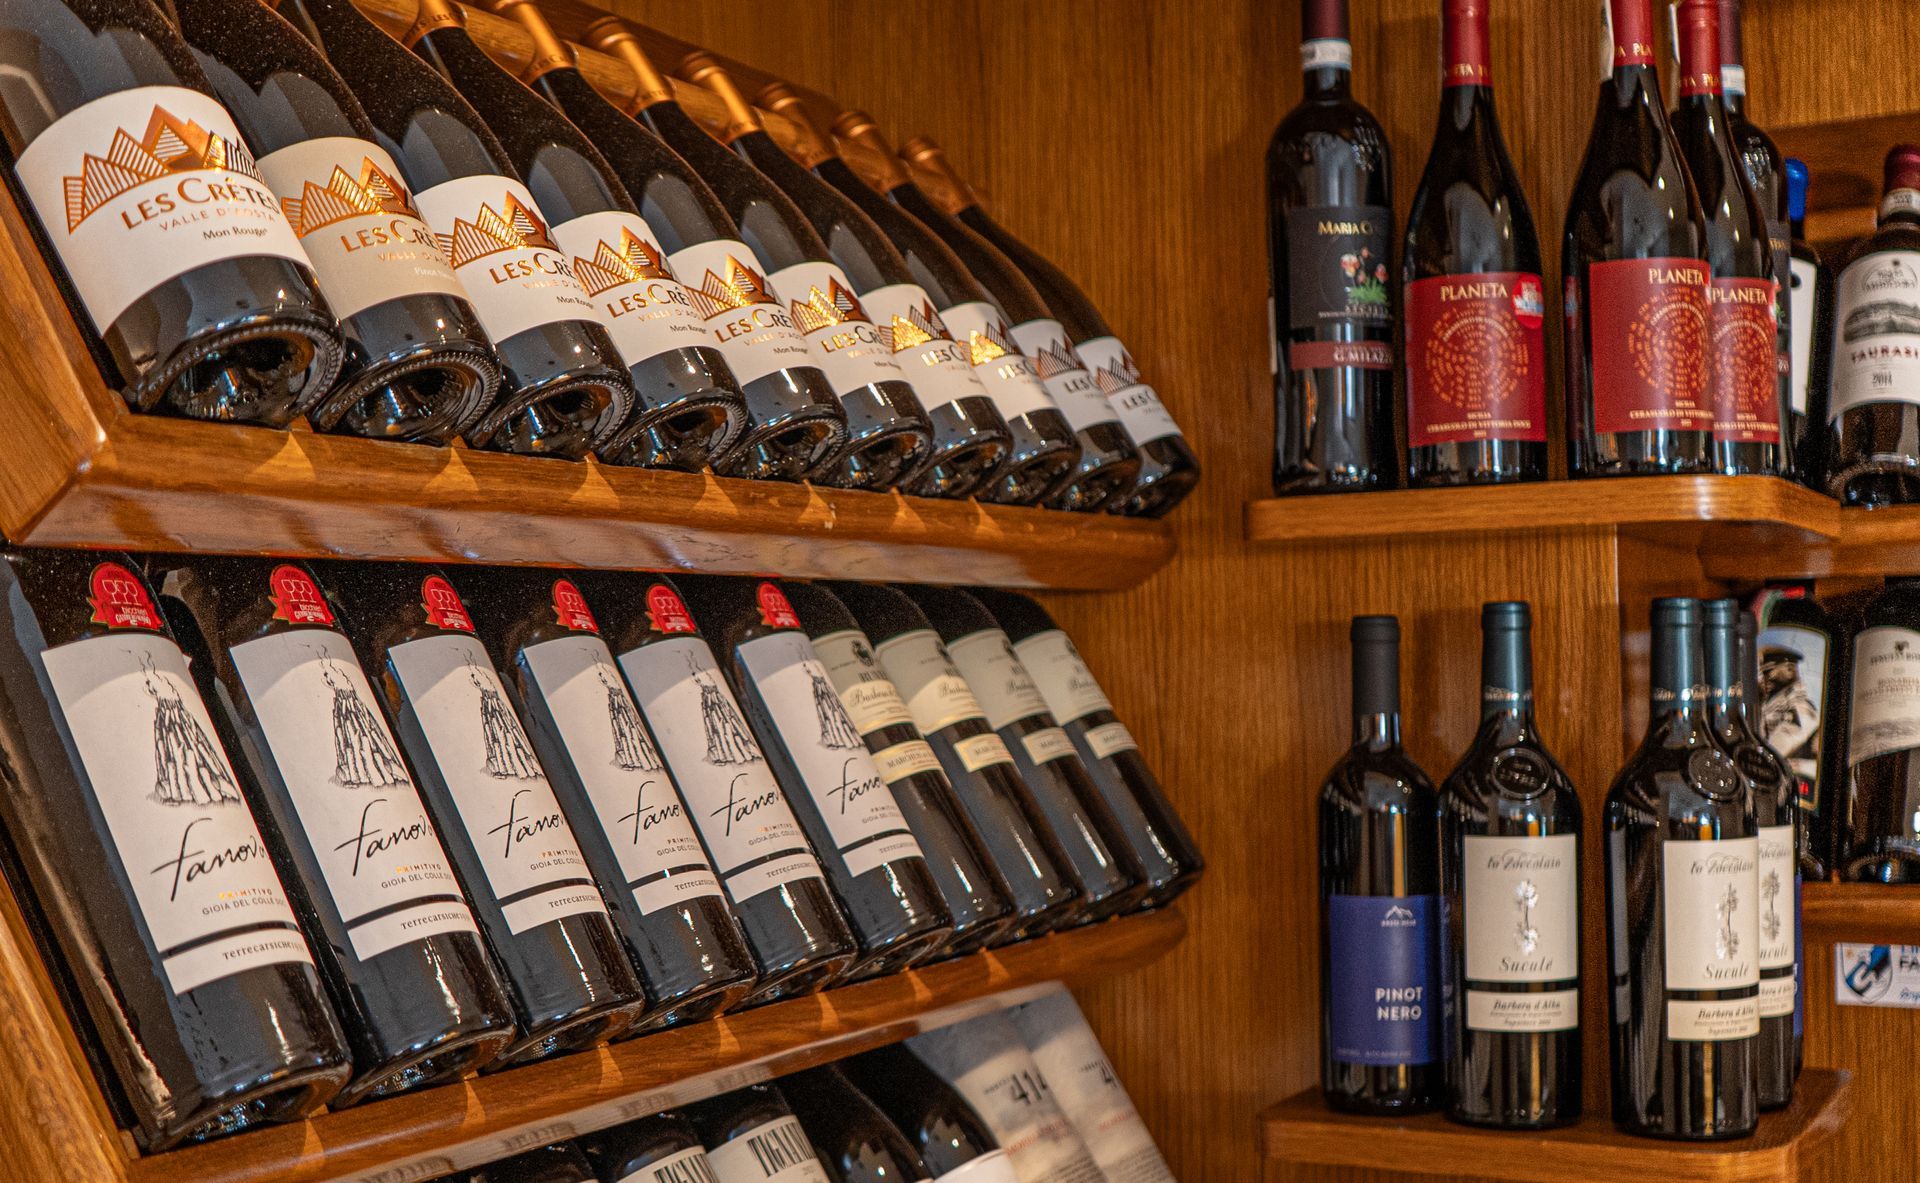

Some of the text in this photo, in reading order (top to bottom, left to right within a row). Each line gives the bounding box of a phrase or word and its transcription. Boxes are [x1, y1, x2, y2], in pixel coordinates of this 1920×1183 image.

[121, 192, 177, 231] LES
[159, 209, 210, 232] VALLE
[1317, 220, 1361, 235] MARIA
[202, 228, 232, 241] Mon
[340, 226, 391, 253] LES
[489, 259, 535, 285] LES
[1649, 268, 1705, 285] PLANETA
[1441, 282, 1508, 302] PLANETA
[1712, 287, 1769, 304] PLANETA
[606, 292, 649, 319] LES
[714, 318, 754, 344] LES
[820, 332, 857, 354] LES
[920, 349, 952, 367] LES
[530, 859, 553, 871] GIOIA
[553, 857, 566, 866] DEL
[380, 878, 407, 890] GIOIA
[408, 873, 424, 882] DEL
[201, 902, 231, 916] GIOIA
[232, 897, 250, 909] DEL
[251, 895, 275, 907] COLLE
[1375, 986, 1424, 1003] PINOT
[1377, 1004, 1422, 1021] NERO
[1493, 999, 1532, 1010] Barbera
[1697, 1008, 1734, 1020] Barbera
